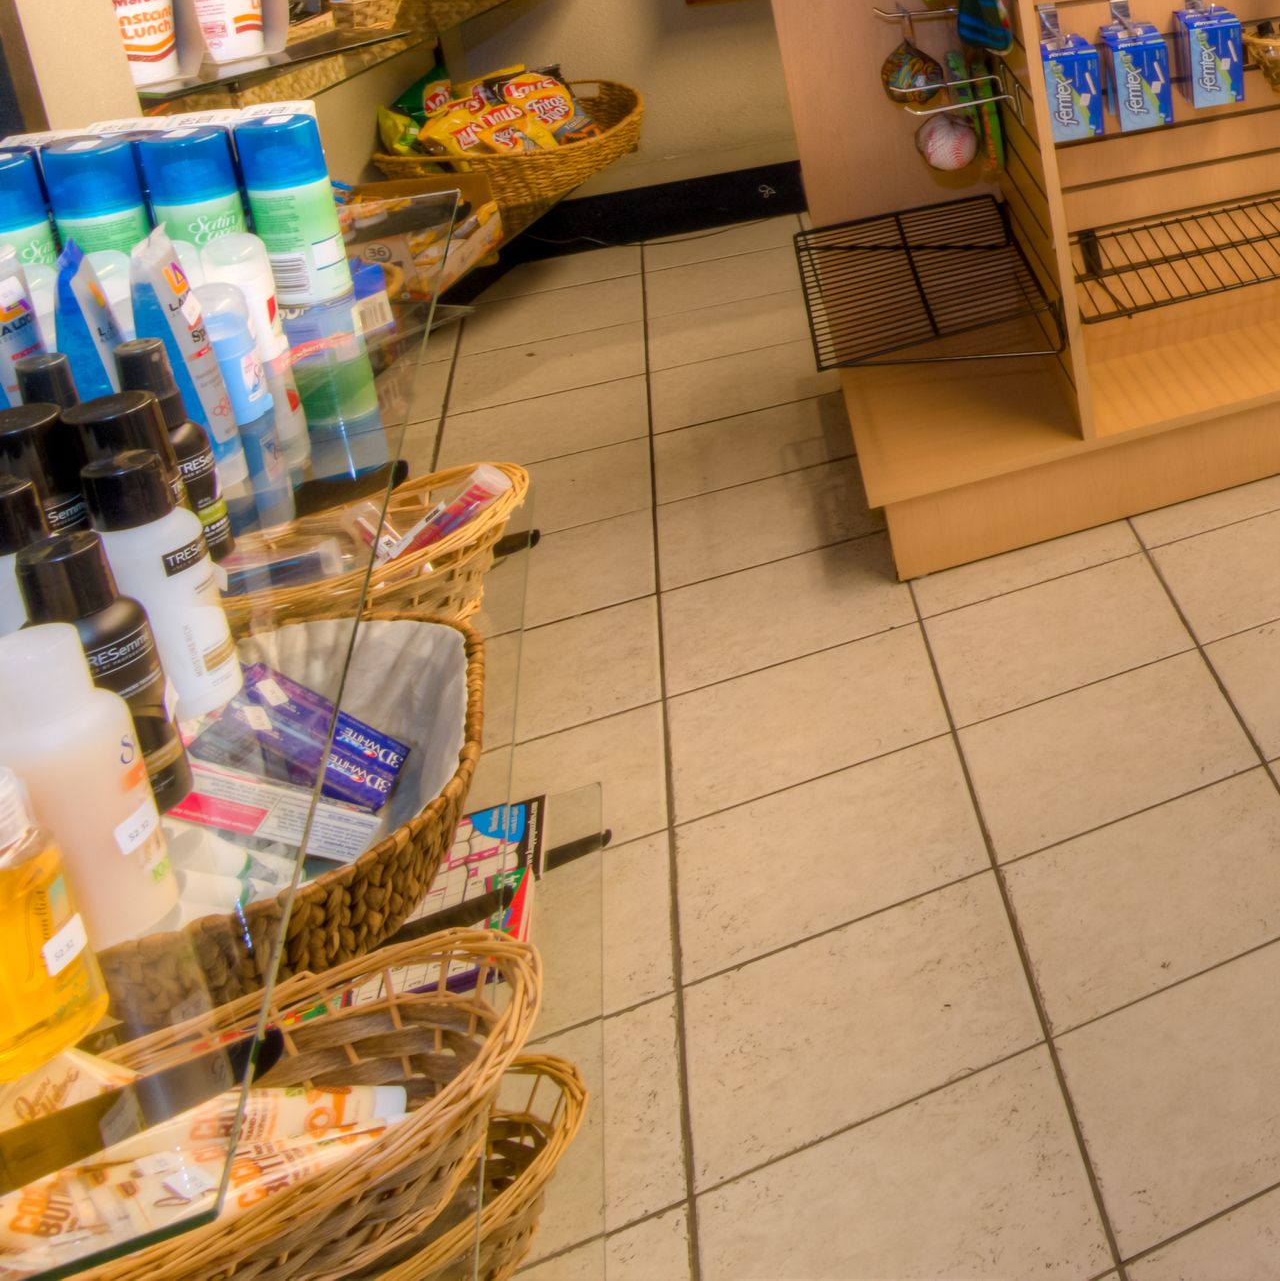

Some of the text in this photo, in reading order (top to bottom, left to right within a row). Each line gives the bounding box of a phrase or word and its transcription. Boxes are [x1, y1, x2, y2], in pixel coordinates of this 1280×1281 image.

[119, 6, 171, 26] nstant
[121, 19, 171, 39] Lunch
[1198, 46, 1221, 92] femtex
[1055, 79, 1079, 126] femtex
[1125, 67, 1149, 115] femtex
[368, 246, 387, 258] 36
[343, 727, 383, 755] WHITE
[328, 753, 369, 780] WHITE
